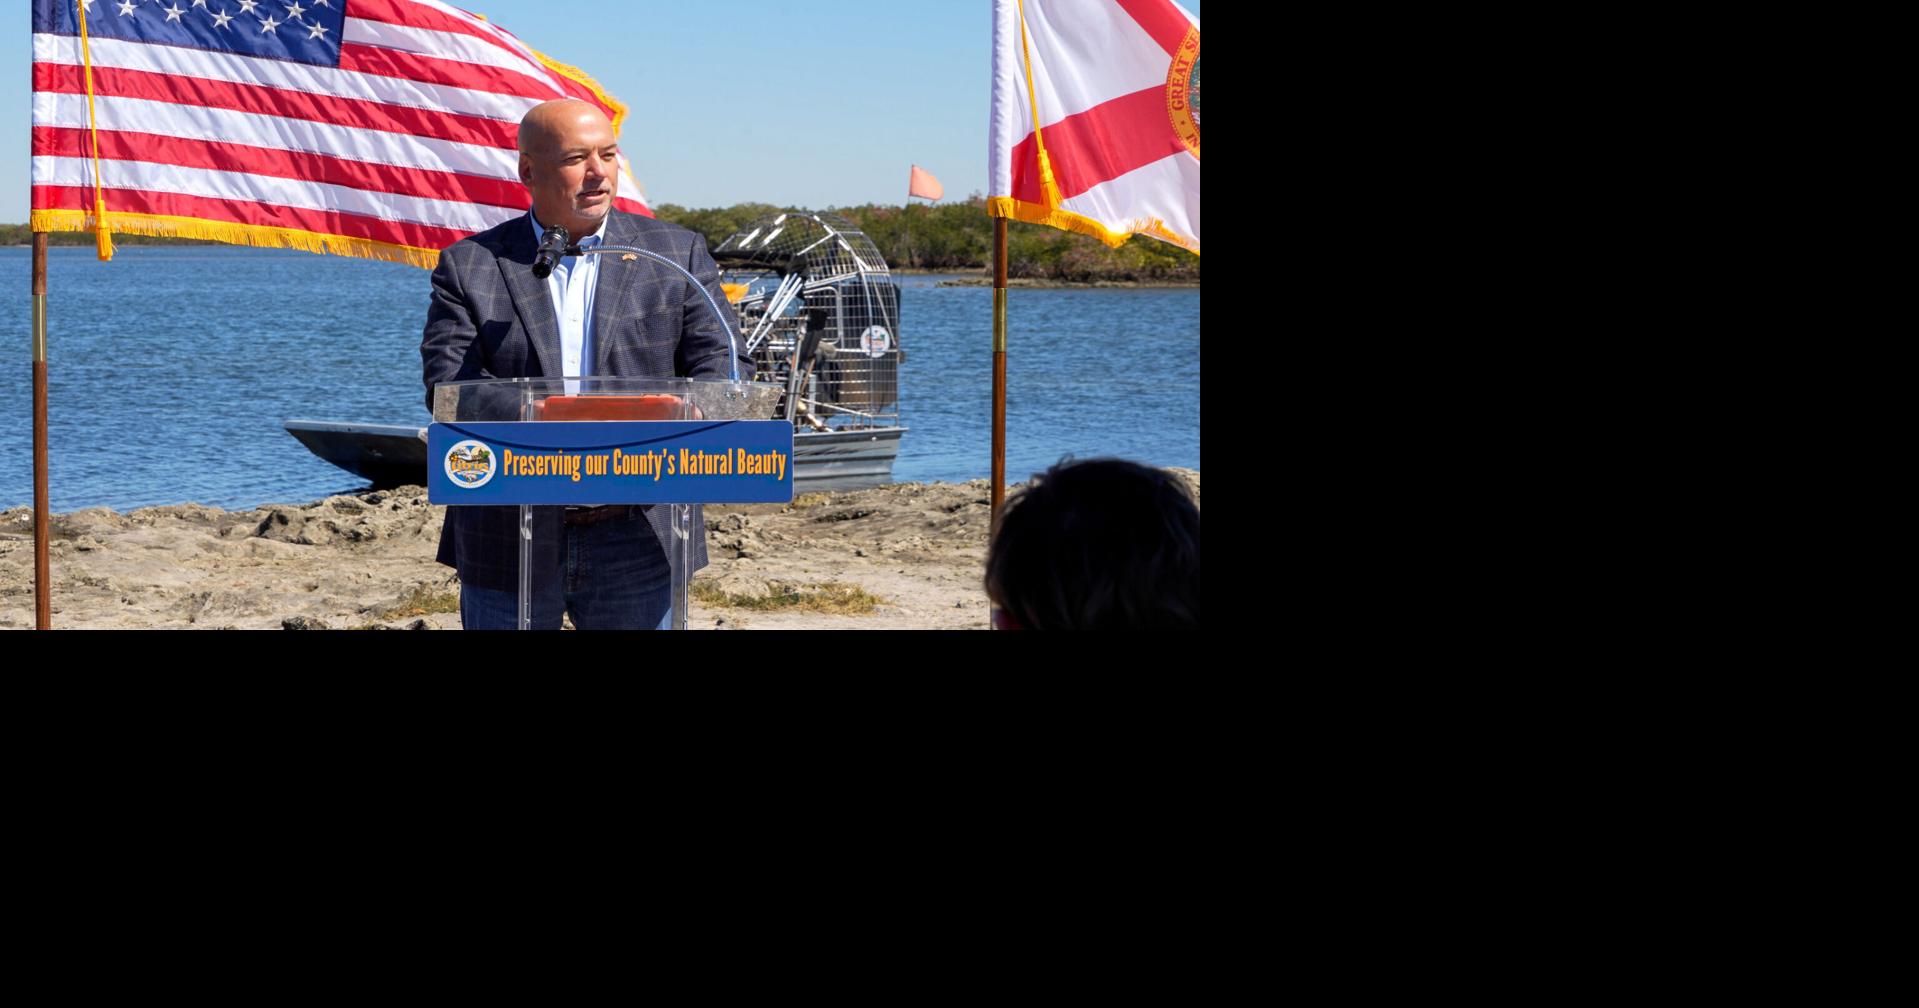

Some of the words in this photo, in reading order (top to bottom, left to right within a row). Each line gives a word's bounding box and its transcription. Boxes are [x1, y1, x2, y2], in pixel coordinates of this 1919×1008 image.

[1171, 56, 1190, 111] GREAT
[503, 448, 582, 482] Preserving
[585, 454, 610, 476] our
[613, 448, 676, 482] County's
[680, 448, 732, 475] Natural
[737, 448, 787, 481] Beauty
